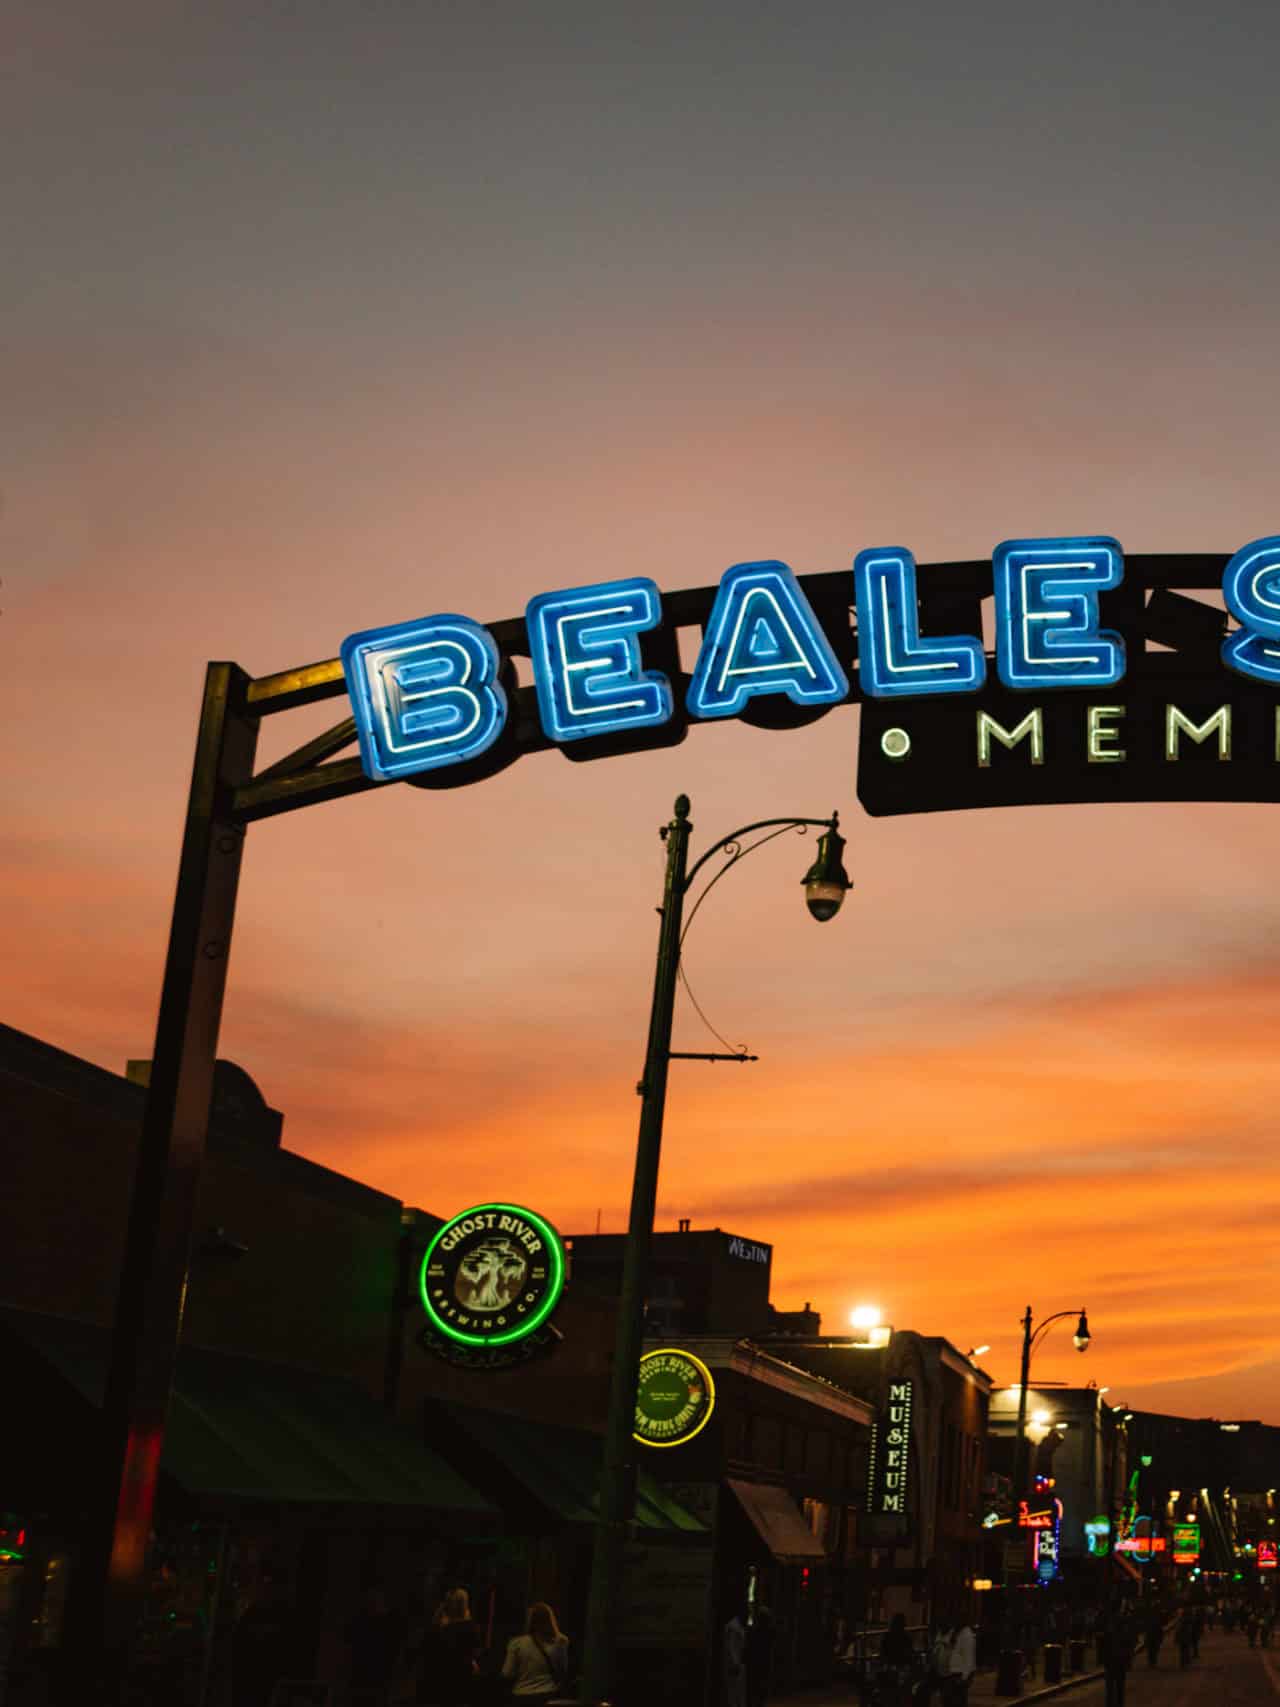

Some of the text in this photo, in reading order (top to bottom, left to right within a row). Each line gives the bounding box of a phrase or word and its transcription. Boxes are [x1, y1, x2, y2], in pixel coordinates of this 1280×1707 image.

[340, 535, 1128, 781] BEALE
[440, 1214, 542, 1254] GHOST RIVER
[728, 1237, 769, 1263] WESTIN
[882, 1384, 906, 1512] MUSEUM
